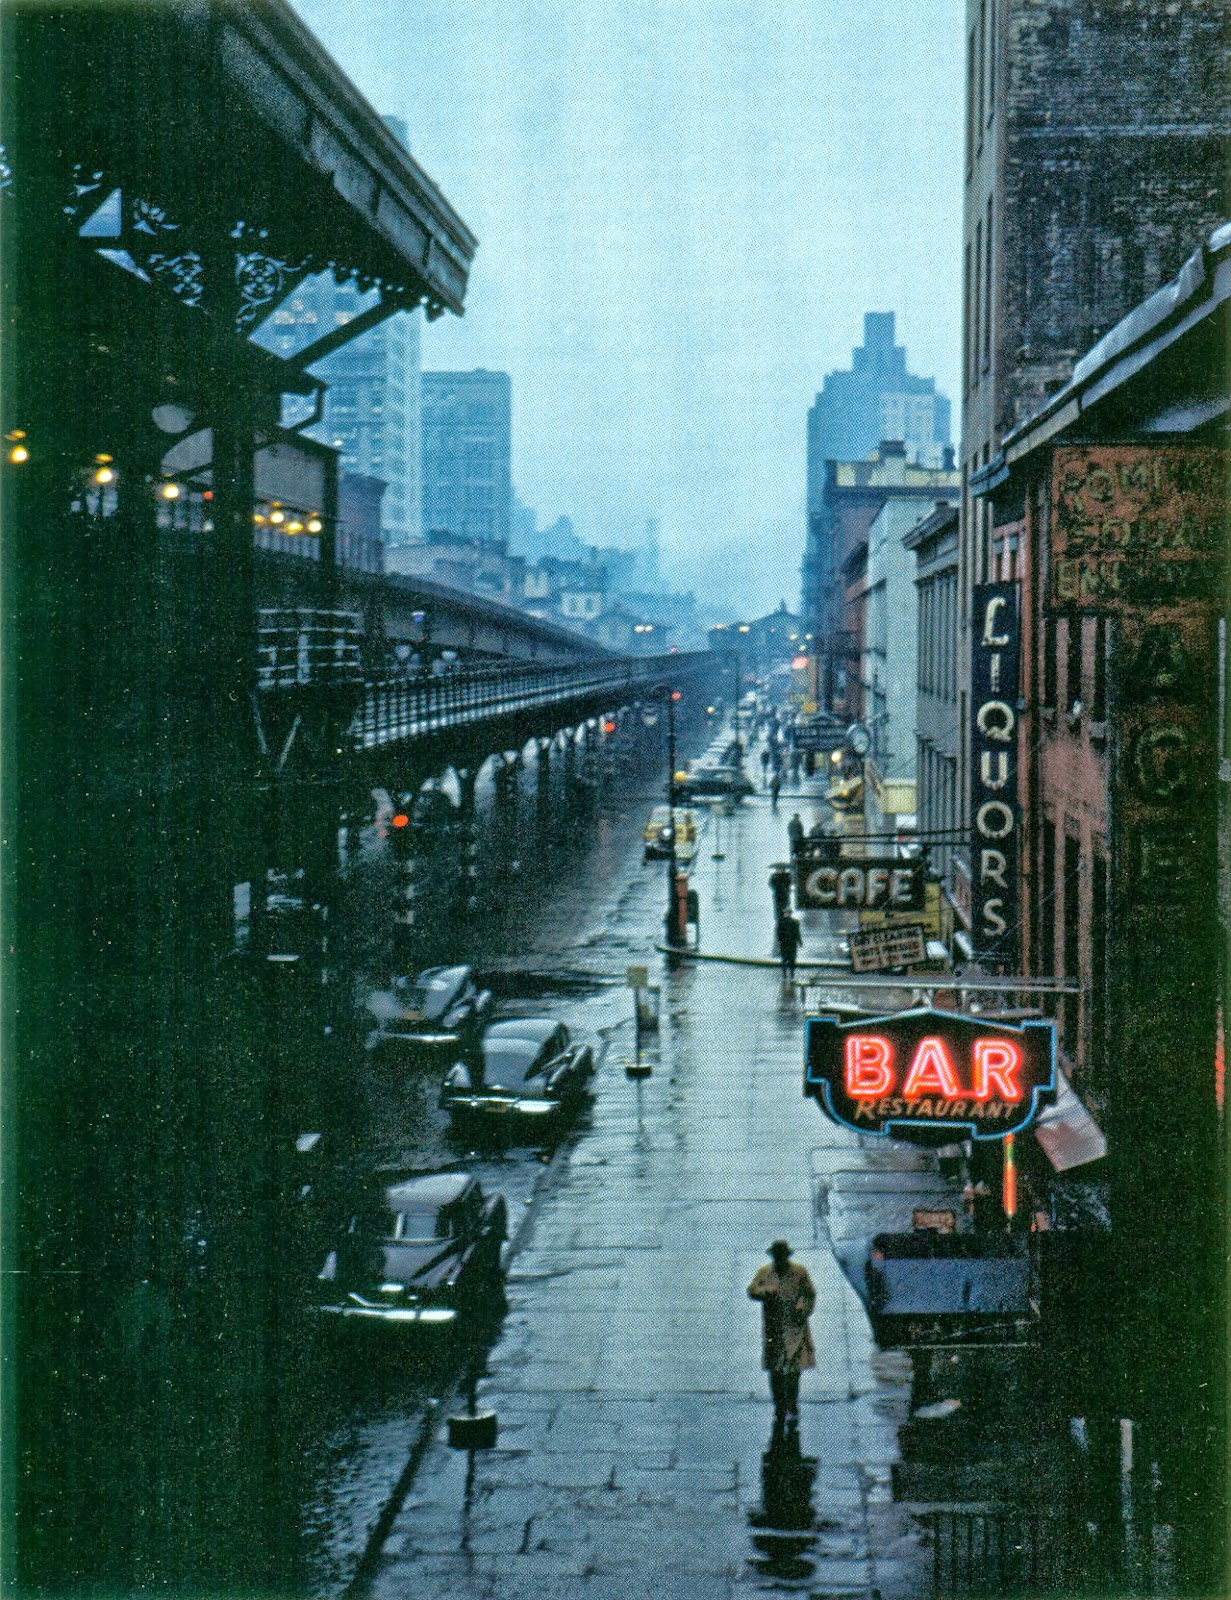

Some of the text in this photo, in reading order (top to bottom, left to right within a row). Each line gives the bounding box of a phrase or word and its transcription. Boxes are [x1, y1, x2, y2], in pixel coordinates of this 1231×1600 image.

[976, 597, 1015, 938] LIQUORS
[806, 867, 913, 904] CAFE
[845, 1034, 1022, 1101] BAR
[854, 1098, 1019, 1120] RESTAURANT
